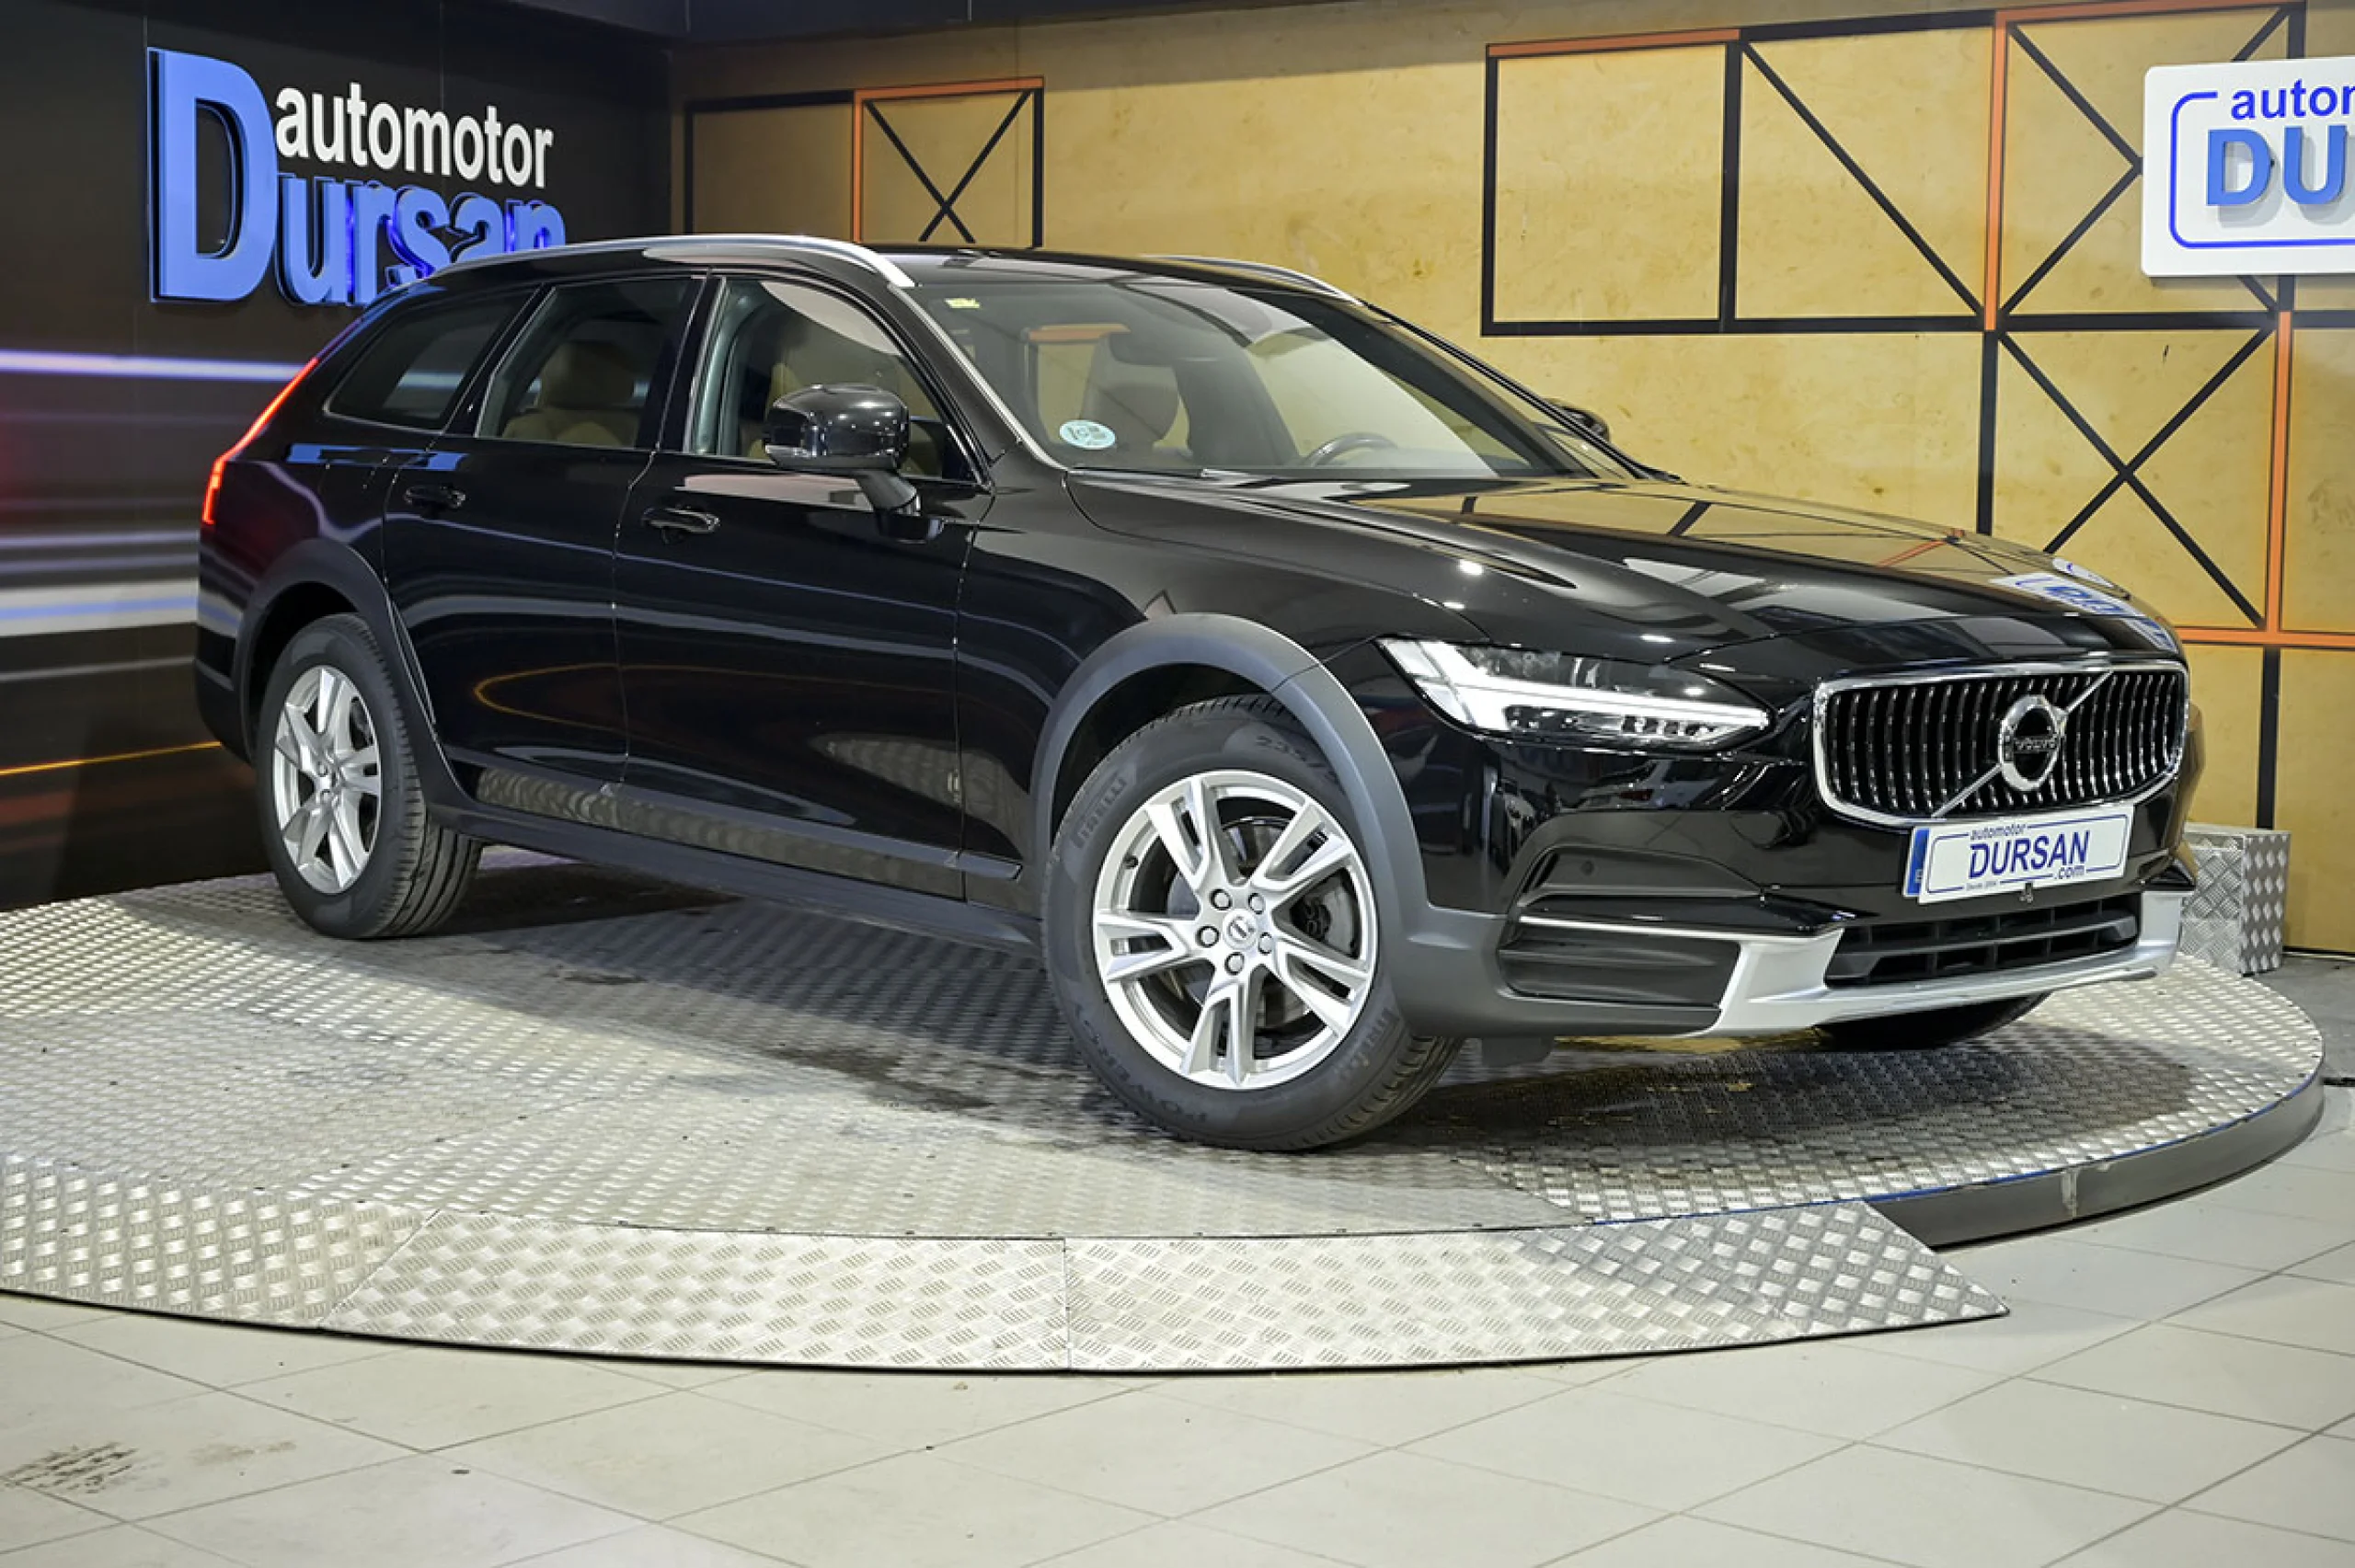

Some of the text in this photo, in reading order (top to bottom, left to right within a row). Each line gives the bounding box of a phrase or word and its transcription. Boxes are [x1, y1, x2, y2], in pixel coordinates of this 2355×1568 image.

[276, 83, 554, 189] automotor
[1968, 830, 2091, 879] DURSAN
[1970, 823, 2028, 841] automotor
